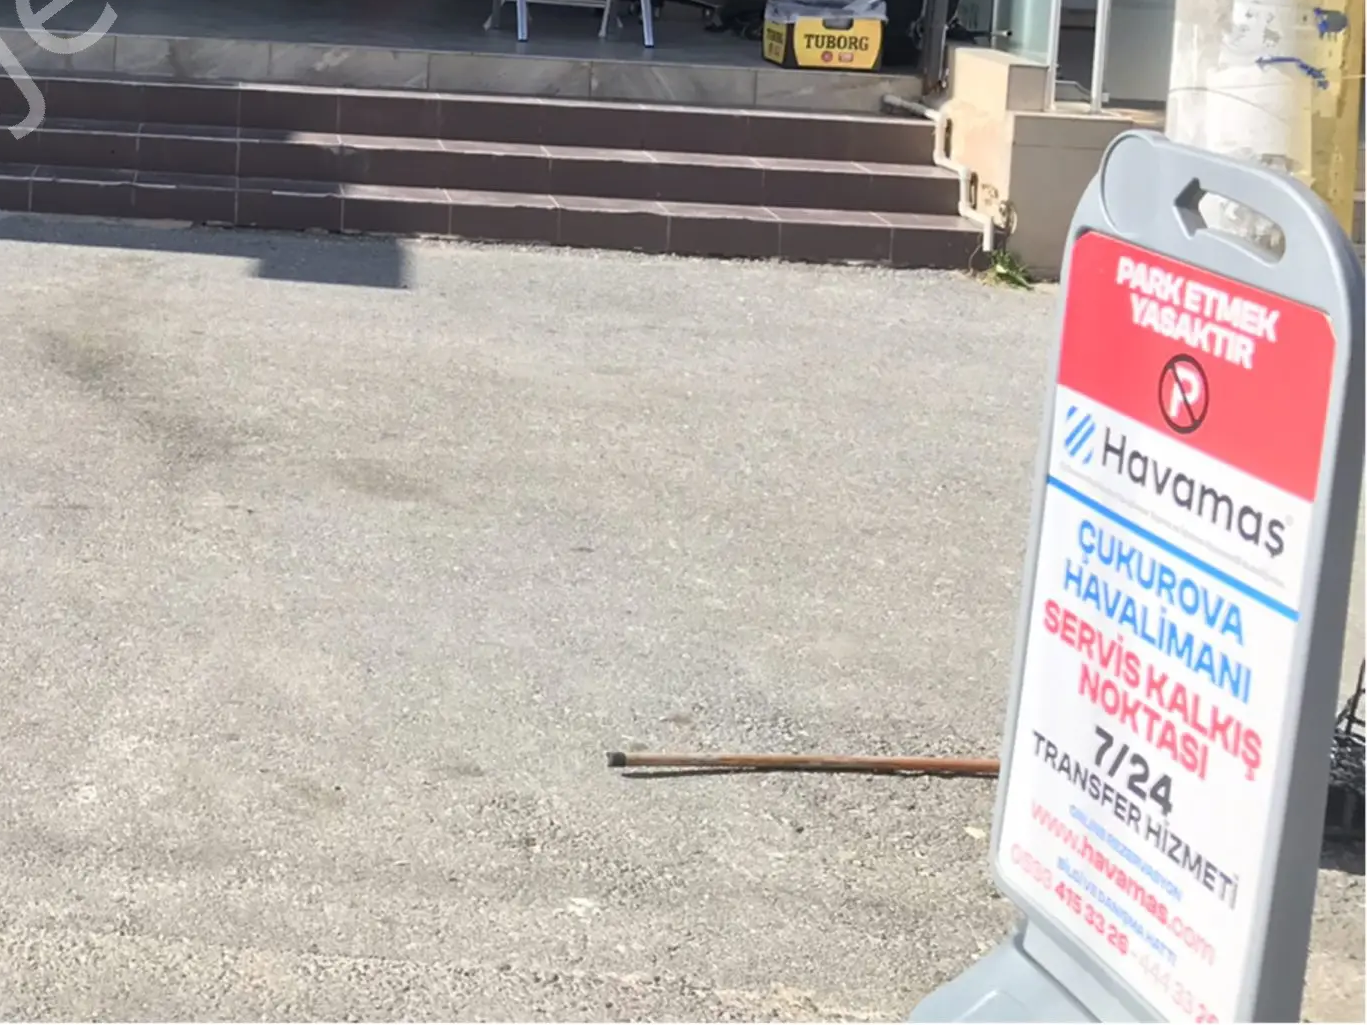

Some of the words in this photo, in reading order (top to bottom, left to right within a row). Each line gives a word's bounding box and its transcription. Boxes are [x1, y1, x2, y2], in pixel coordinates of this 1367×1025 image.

[803, 33, 870, 52] TUBORG
[1116, 255, 1185, 307] PARK
[1184, 279, 1281, 343] ETMEK
[1129, 292, 1256, 369] YASAKTIR
[1102, 426, 1286, 559] Havamaş
[1063, 558, 1252, 705] HAVALİMANI
[1078, 518, 1245, 646] ÇUKUROVA
[1043, 597, 1142, 689] SERVİS
[1145, 663, 1263, 781] KALKIŞ
[1077, 662, 1209, 781] NOKTASI
[1032, 729, 1142, 834] TRANSFER
[1144, 812, 1241, 911] HİZMETİ
[1094, 725, 1173, 817] 7/24
